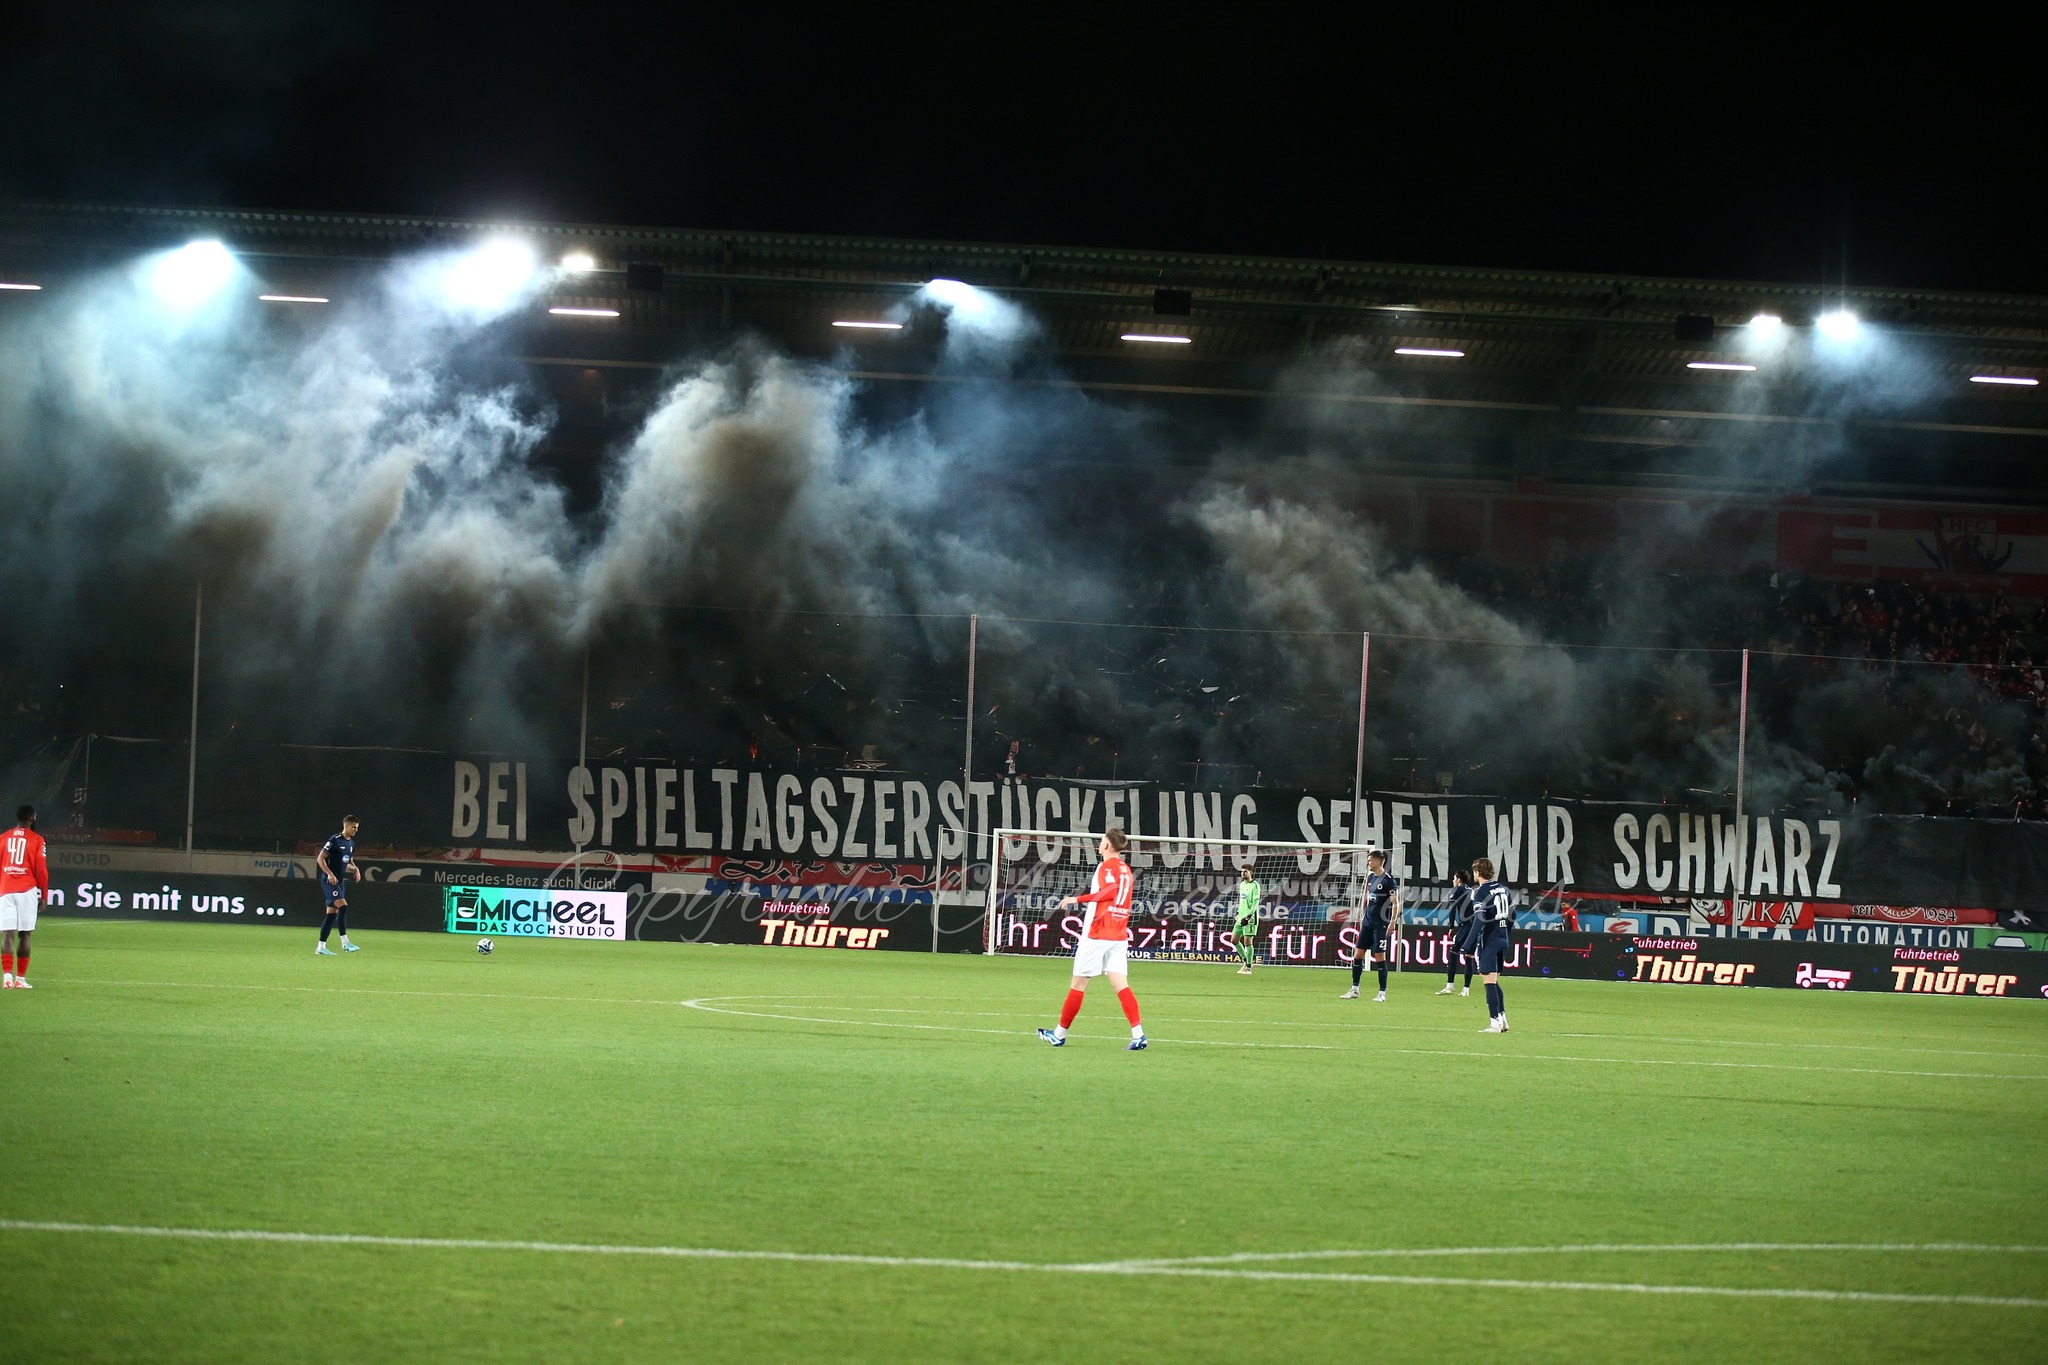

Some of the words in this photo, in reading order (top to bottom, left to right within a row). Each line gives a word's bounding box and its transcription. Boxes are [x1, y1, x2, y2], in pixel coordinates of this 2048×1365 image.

[451, 760, 527, 841] BEI
[566, 766, 1259, 871] SPIELTAGSZERSTÜCKELUNG
[1297, 796, 1449, 881] SEHEN
[1484, 804, 1575, 885] WIR
[1613, 812, 1842, 898] SCHWARZ
[7, 837, 27, 865] 40
[60, 853, 111, 866] NORD
[255, 860, 288, 868] NORD
[434, 870, 539, 888] Mercedes-Benz
[543, 875, 576, 889] such
[583, 877, 617, 890] dich!
[76, 882, 122, 909] Sie
[132, 885, 182, 911] mit
[191, 895, 245, 914] uns
[762, 901, 831, 914] Fuhrbetrieb
[1493, 893, 1509, 920] 10
[1923, 907, 1957, 922] 1984
[479, 922, 508, 933] DAS
[513, 923, 615, 938] KOCHSTUDIO
[760, 919, 890, 948] Thürer
[996, 913, 1048, 948] Ihr
[1060, 915, 1237, 952] Szialis
[1268, 925, 1326, 960] für
[1806, 924, 1969, 949] AUTOMATION
[1154, 952, 1221, 962] SPIELBANK
[1225, 954, 1263, 964] HAE
[1893, 948, 1960, 961] Fuhrbetrieb
[1632, 955, 1755, 985] Thürer
[1891, 965, 2018, 995] Thürer
